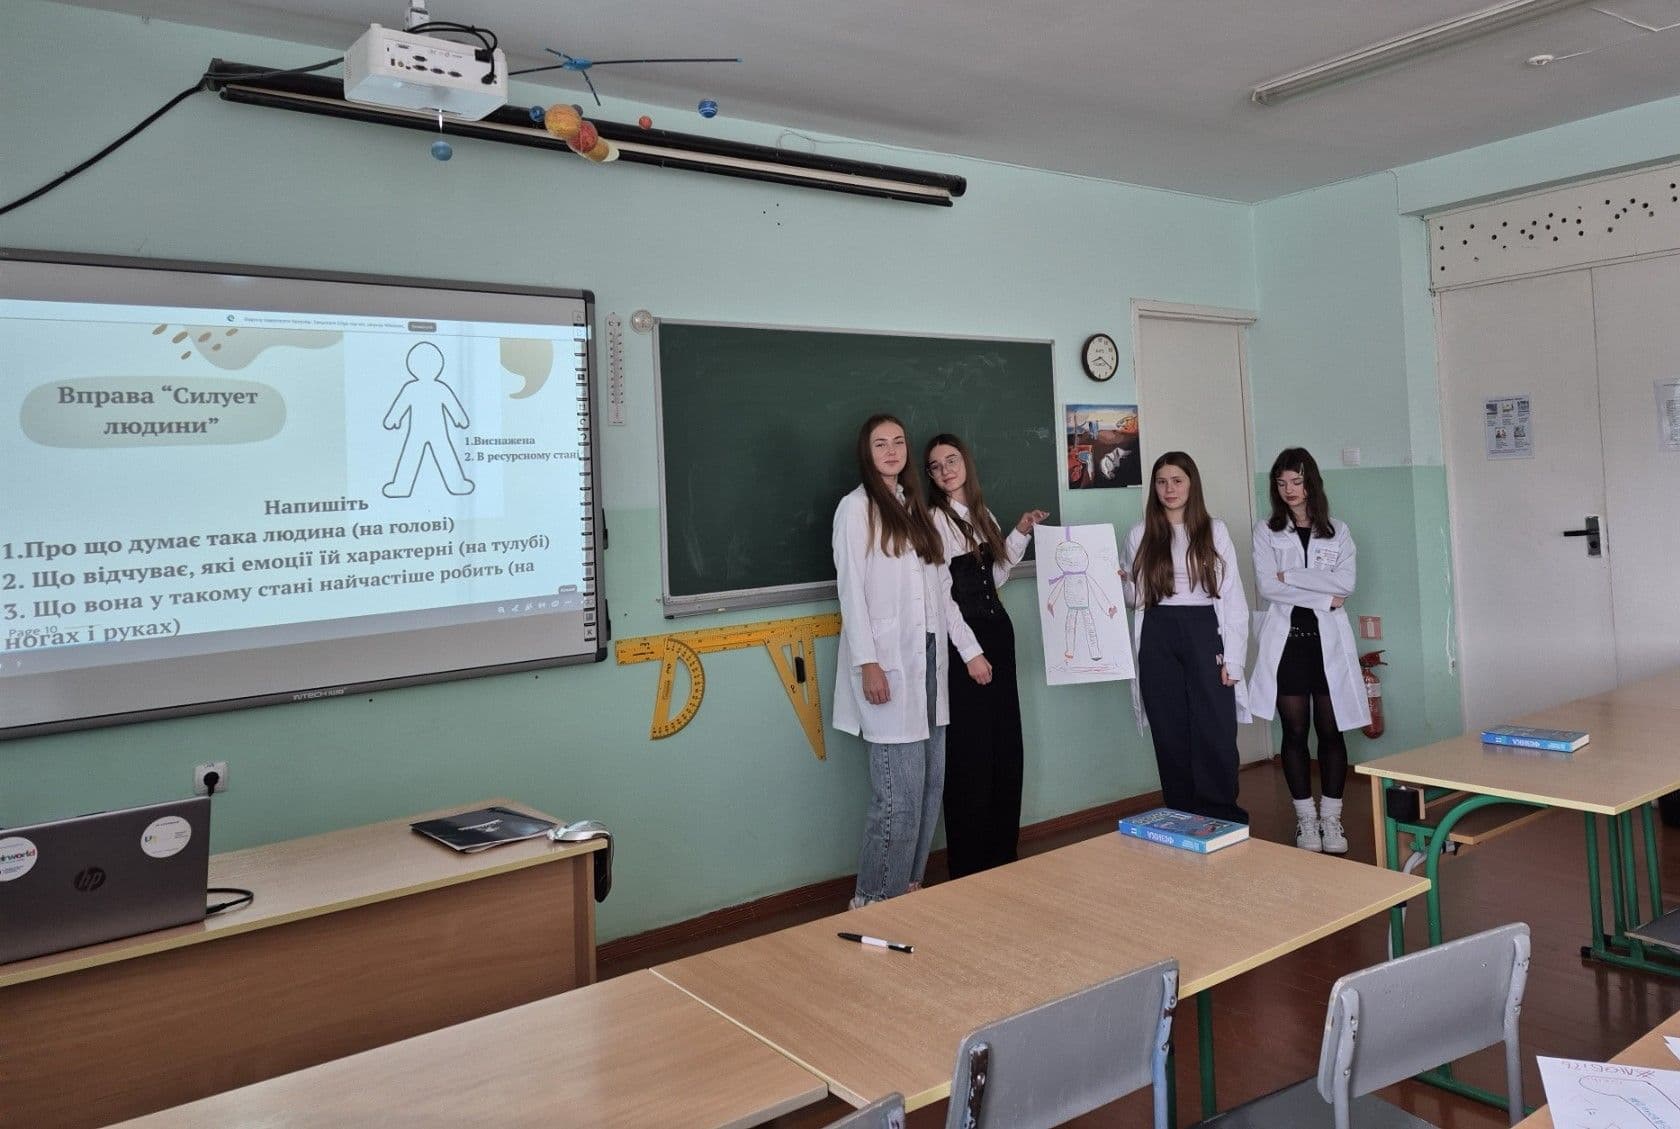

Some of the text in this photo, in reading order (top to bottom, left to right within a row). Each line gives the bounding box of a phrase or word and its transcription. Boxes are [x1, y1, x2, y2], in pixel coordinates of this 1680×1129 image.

[57, 386, 154, 407] Вправа
[464, 452, 474, 461] 2.
[477, 452, 485, 461] В
[487, 452, 550, 462] ресурсному
[264, 497, 369, 515] Напишіть
[3, 517, 455, 560] 1.Про що думає така людина (на голові)
[2, 534, 550, 590] 2. Що відчуває, які емоції їй характерні (на тулубі)
[4, 560, 535, 620] 3. Що вона у такому стані найчастіше робить (на
[5, 618, 182, 650] ногах і руках)
[78, 867, 104, 892] hp
